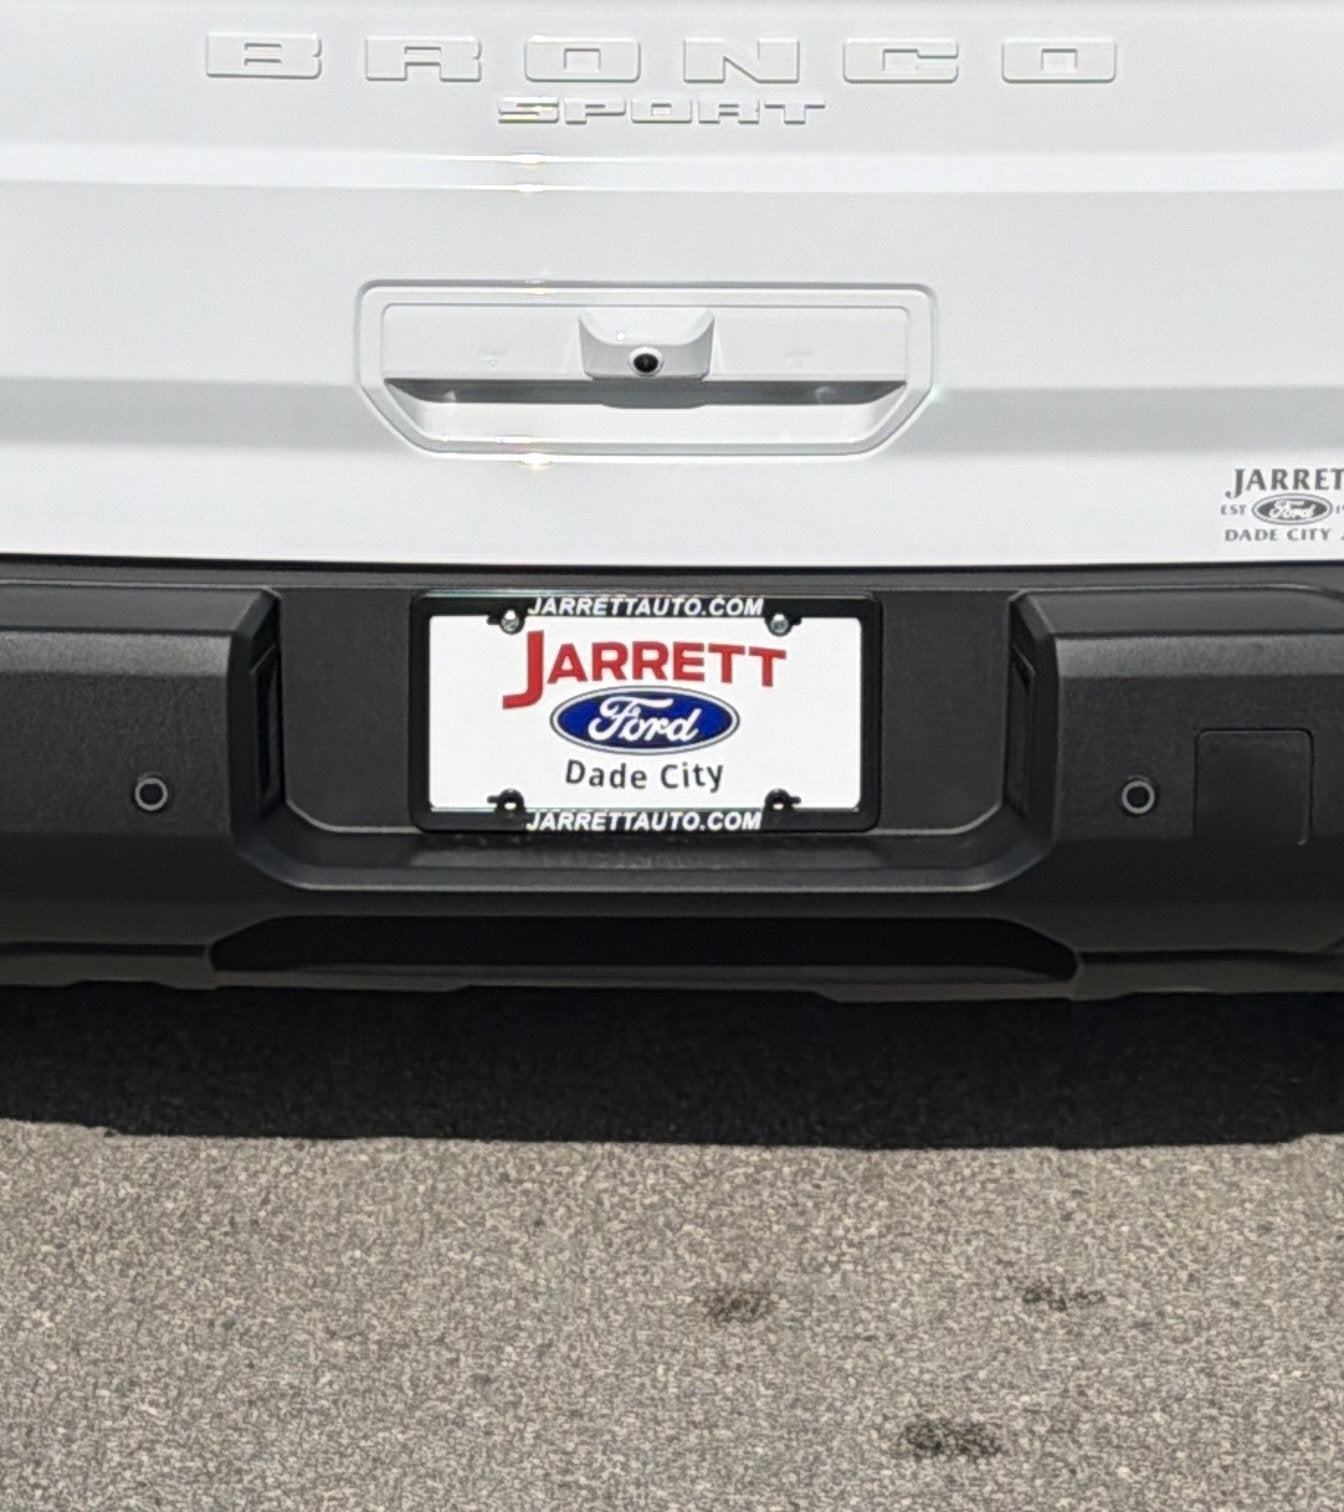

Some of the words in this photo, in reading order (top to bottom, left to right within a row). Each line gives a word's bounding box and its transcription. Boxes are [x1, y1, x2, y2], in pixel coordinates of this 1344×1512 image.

[204, 31, 1118, 84] BRONCO
[497, 95, 826, 126] SPORT
[1220, 504, 1247, 515] EST
[1225, 529, 1278, 542] DADE
[1286, 528, 1331, 541] CITY
[527, 597, 764, 617] JARRETTAUTO.COM
[502, 629, 787, 710] JARRETT
[588, 696, 700, 743] Ford
[565, 759, 647, 789] Dade
[660, 762, 724, 792] City
[526, 811, 762, 831] JARRETTAUTO.COM
